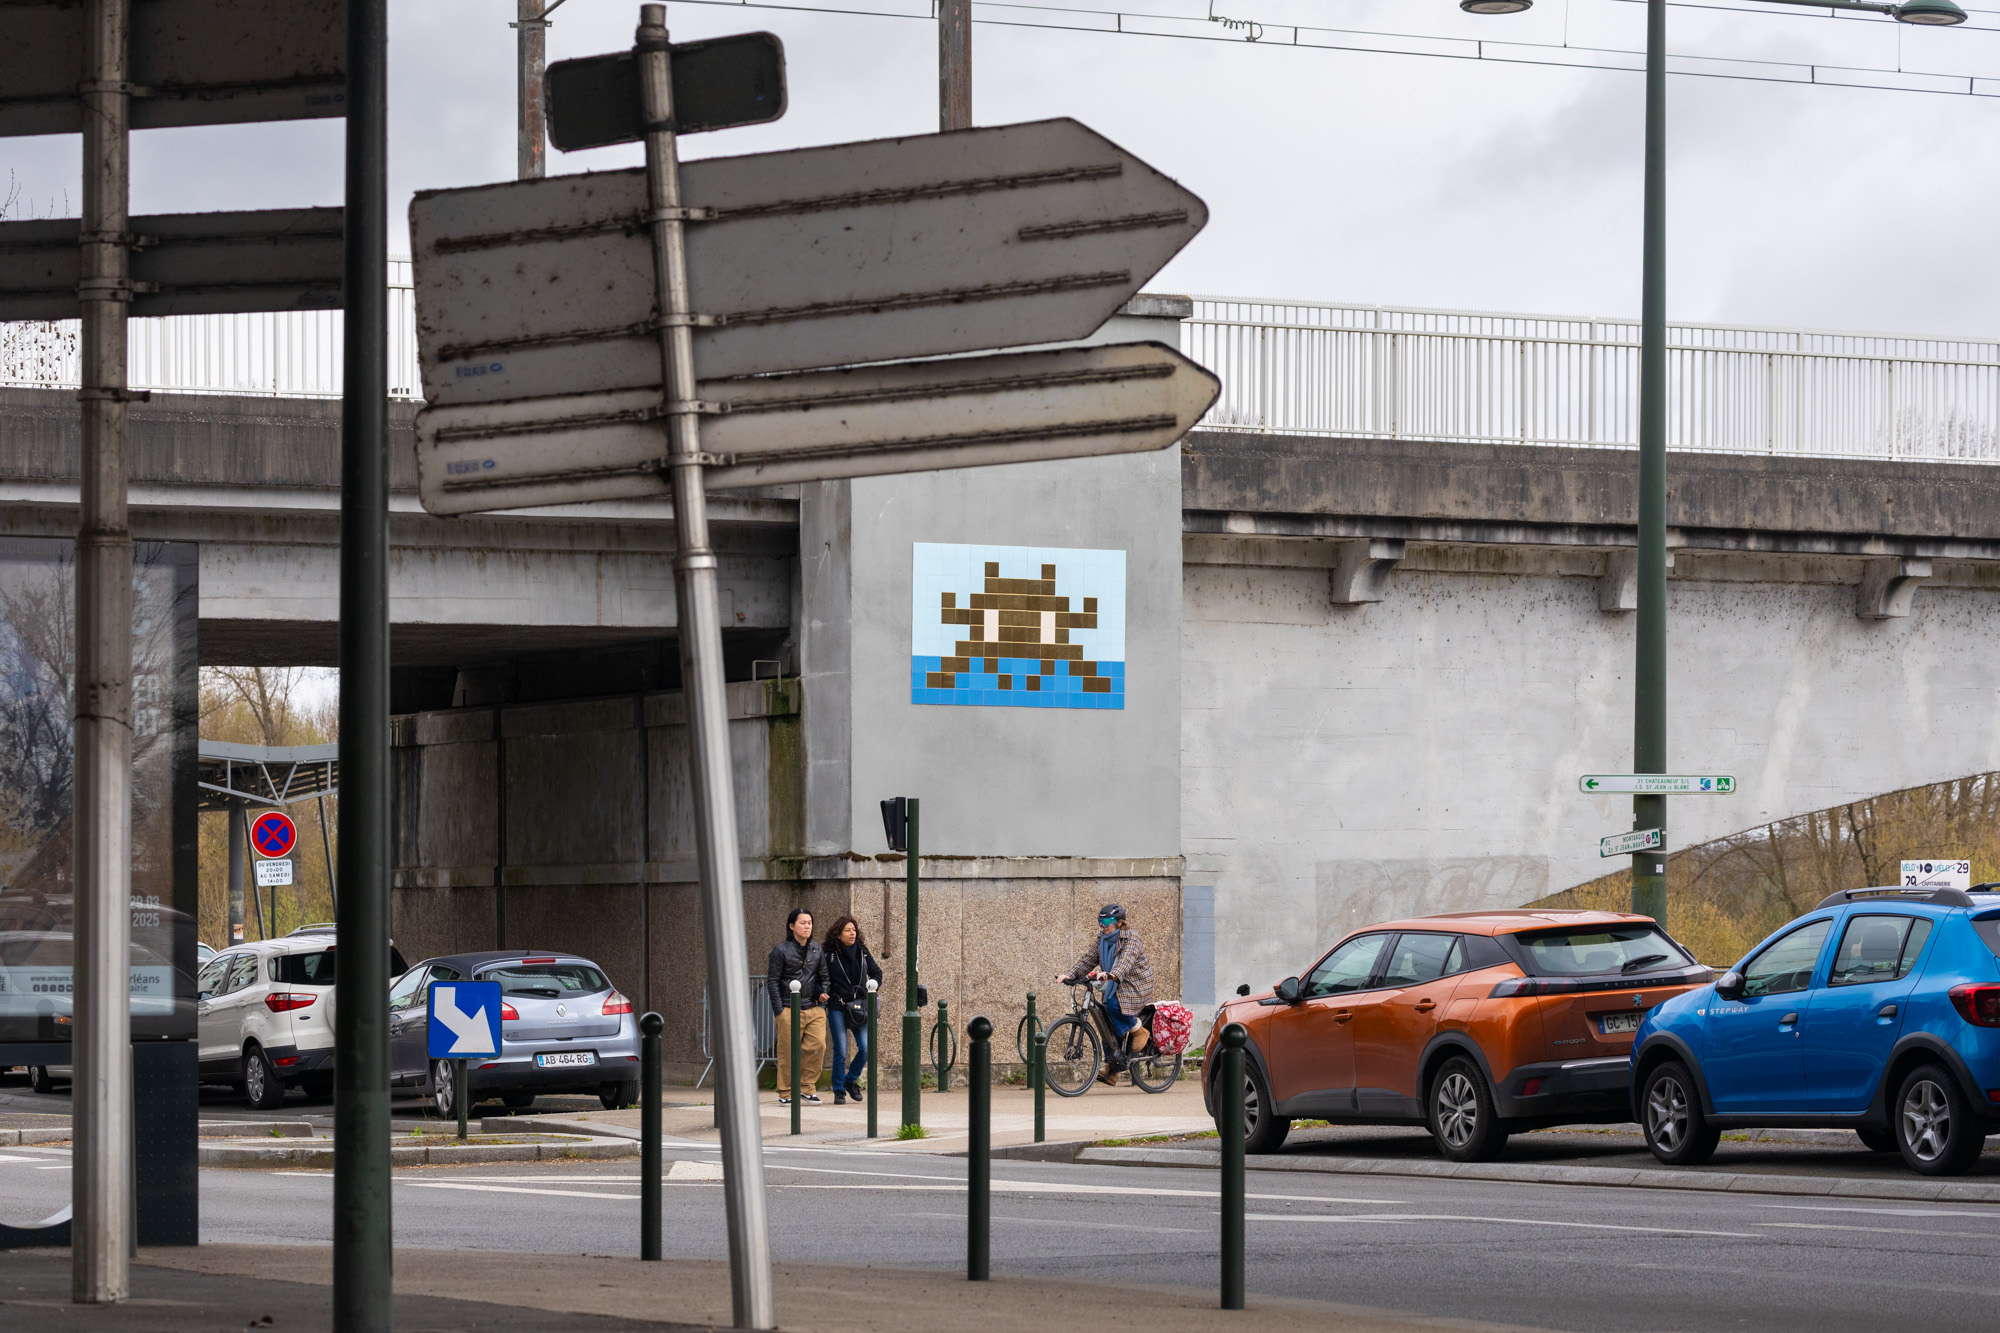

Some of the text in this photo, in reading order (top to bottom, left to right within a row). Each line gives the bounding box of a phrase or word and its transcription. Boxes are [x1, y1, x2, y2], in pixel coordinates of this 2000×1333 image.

[1622, 833, 1645, 842] MONTARGIS
[1956, 862, 1969, 874] 29
[132, 912, 160, 927] 2025
[129, 973, 160, 984] rléans
[129, 984, 149, 992] airie
[1710, 1006, 1750, 1016] STEPWAY
